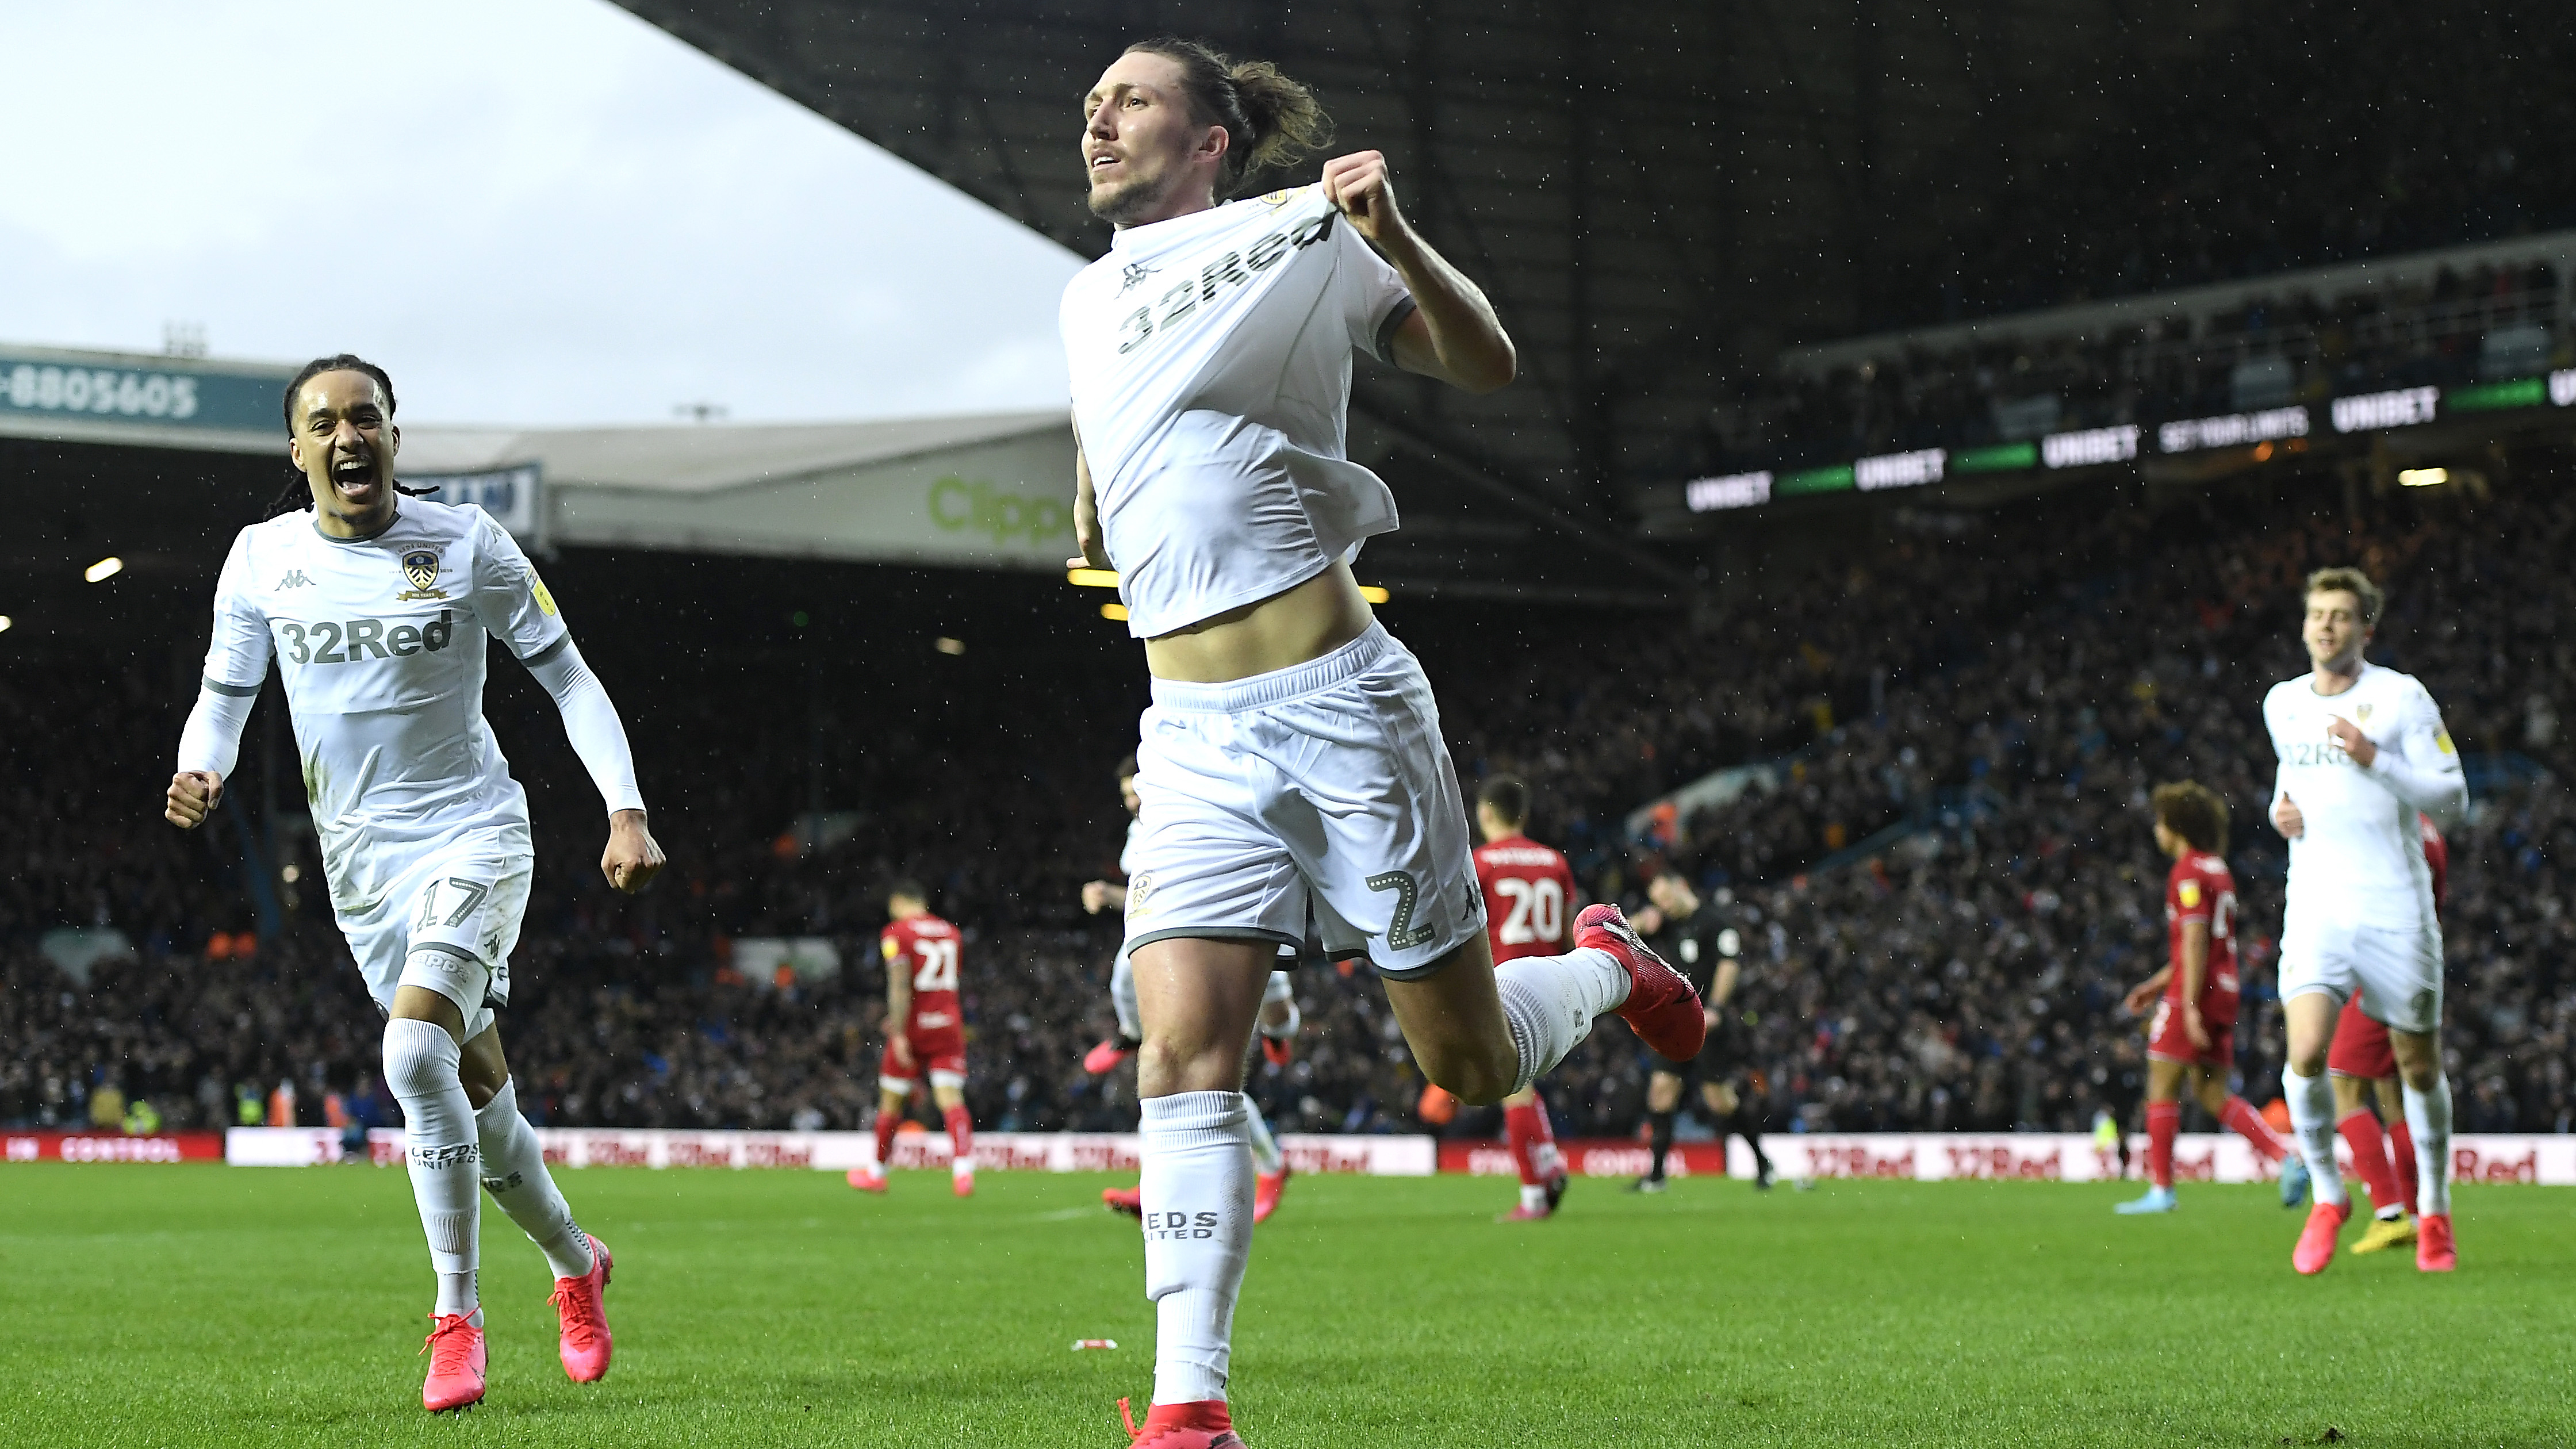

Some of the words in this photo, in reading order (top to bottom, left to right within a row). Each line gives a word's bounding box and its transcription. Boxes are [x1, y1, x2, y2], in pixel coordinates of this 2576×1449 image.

[1118, 204, 1337, 355] 32Red
[282, 610, 453, 665] 32Red
[417, 876, 488, 934] 17
[1365, 869, 1436, 951] 2
[1495, 877, 1563, 945] 20
[413, 1155, 477, 1170] UNITED
[1148, 1212, 1218, 1229] EDS
